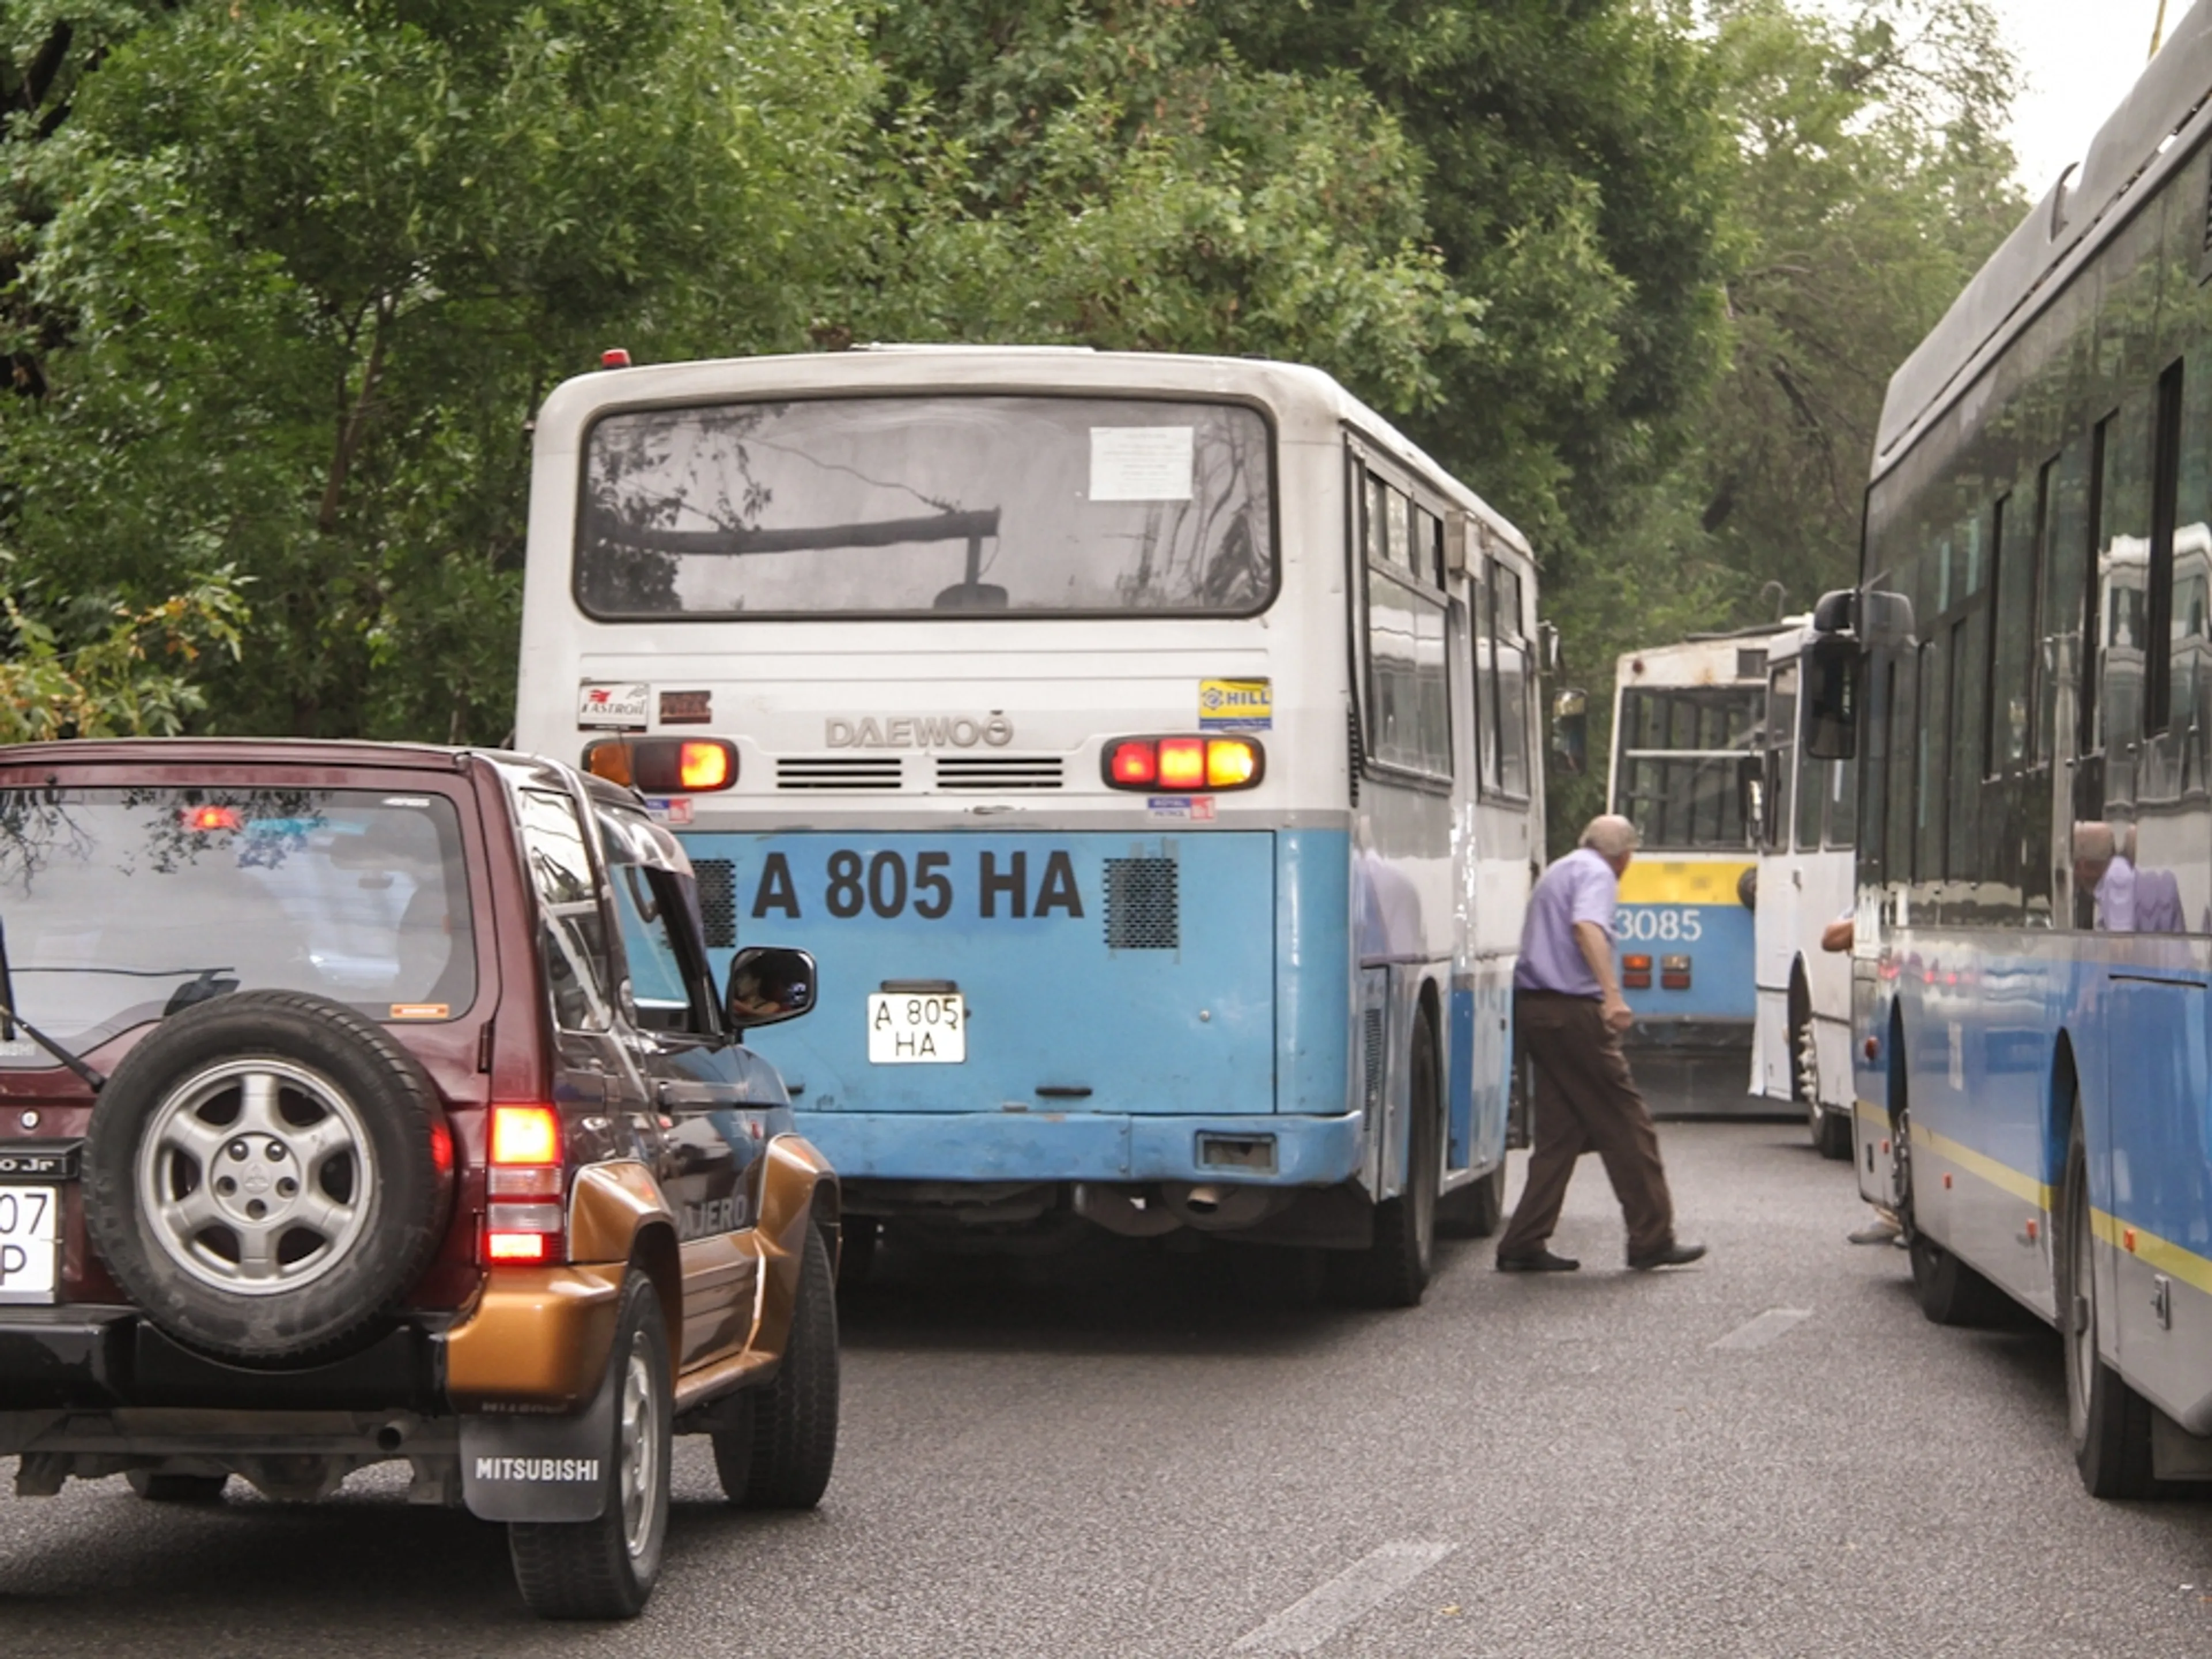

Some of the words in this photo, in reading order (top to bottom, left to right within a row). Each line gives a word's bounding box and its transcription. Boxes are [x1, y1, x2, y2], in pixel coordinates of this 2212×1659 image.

[1226, 691, 1271, 705] HILL
[825, 717, 1014, 748] DAEWOO
[751, 852, 802, 919] A
[825, 850, 953, 919] 805
[979, 851, 1085, 919] HA
[1616, 908, 1702, 941] 3085
[874, 1000, 892, 1031] A
[907, 997, 959, 1029] 805
[896, 1031, 937, 1056] HA
[21, 1158, 54, 1171] Jr
[475, 1457, 599, 1481] MITSUBISHI
